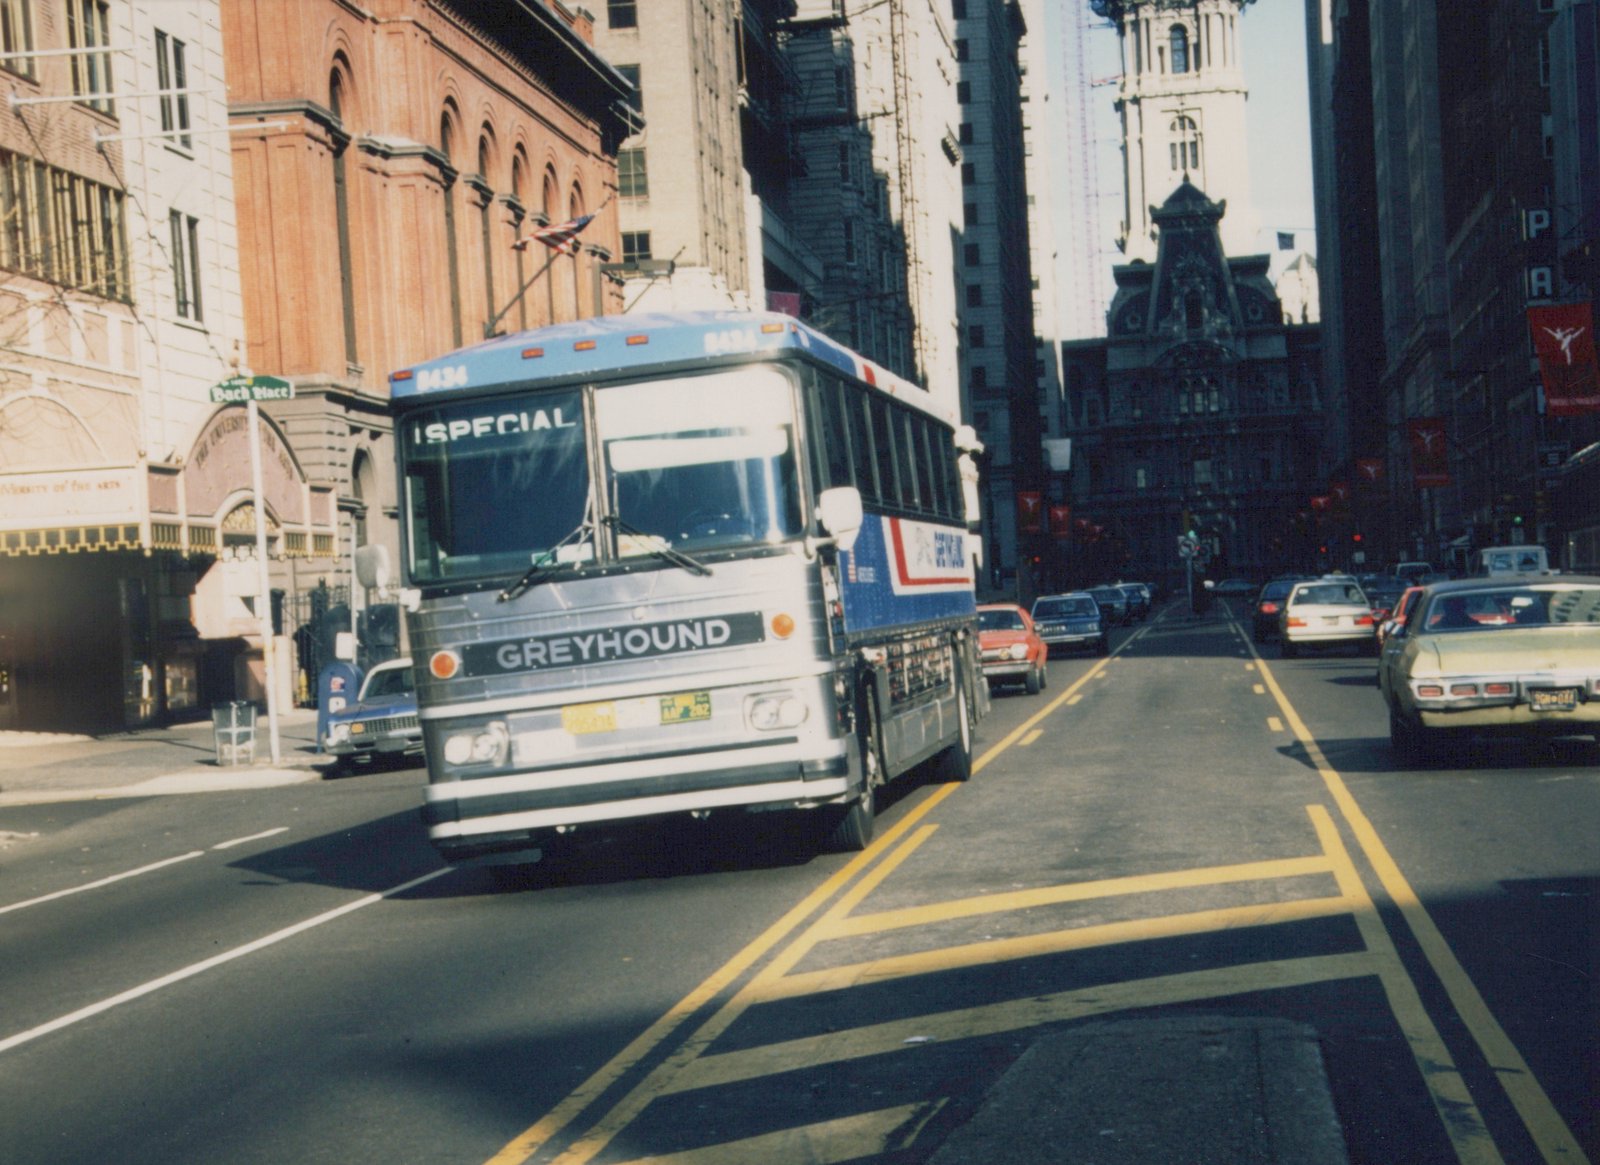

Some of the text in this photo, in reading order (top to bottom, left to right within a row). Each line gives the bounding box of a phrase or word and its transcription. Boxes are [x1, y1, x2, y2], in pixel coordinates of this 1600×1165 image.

[416, 365, 468, 392] 8434
[252, 386, 289, 400] Place
[496, 619, 731, 670] GREYHOUND
